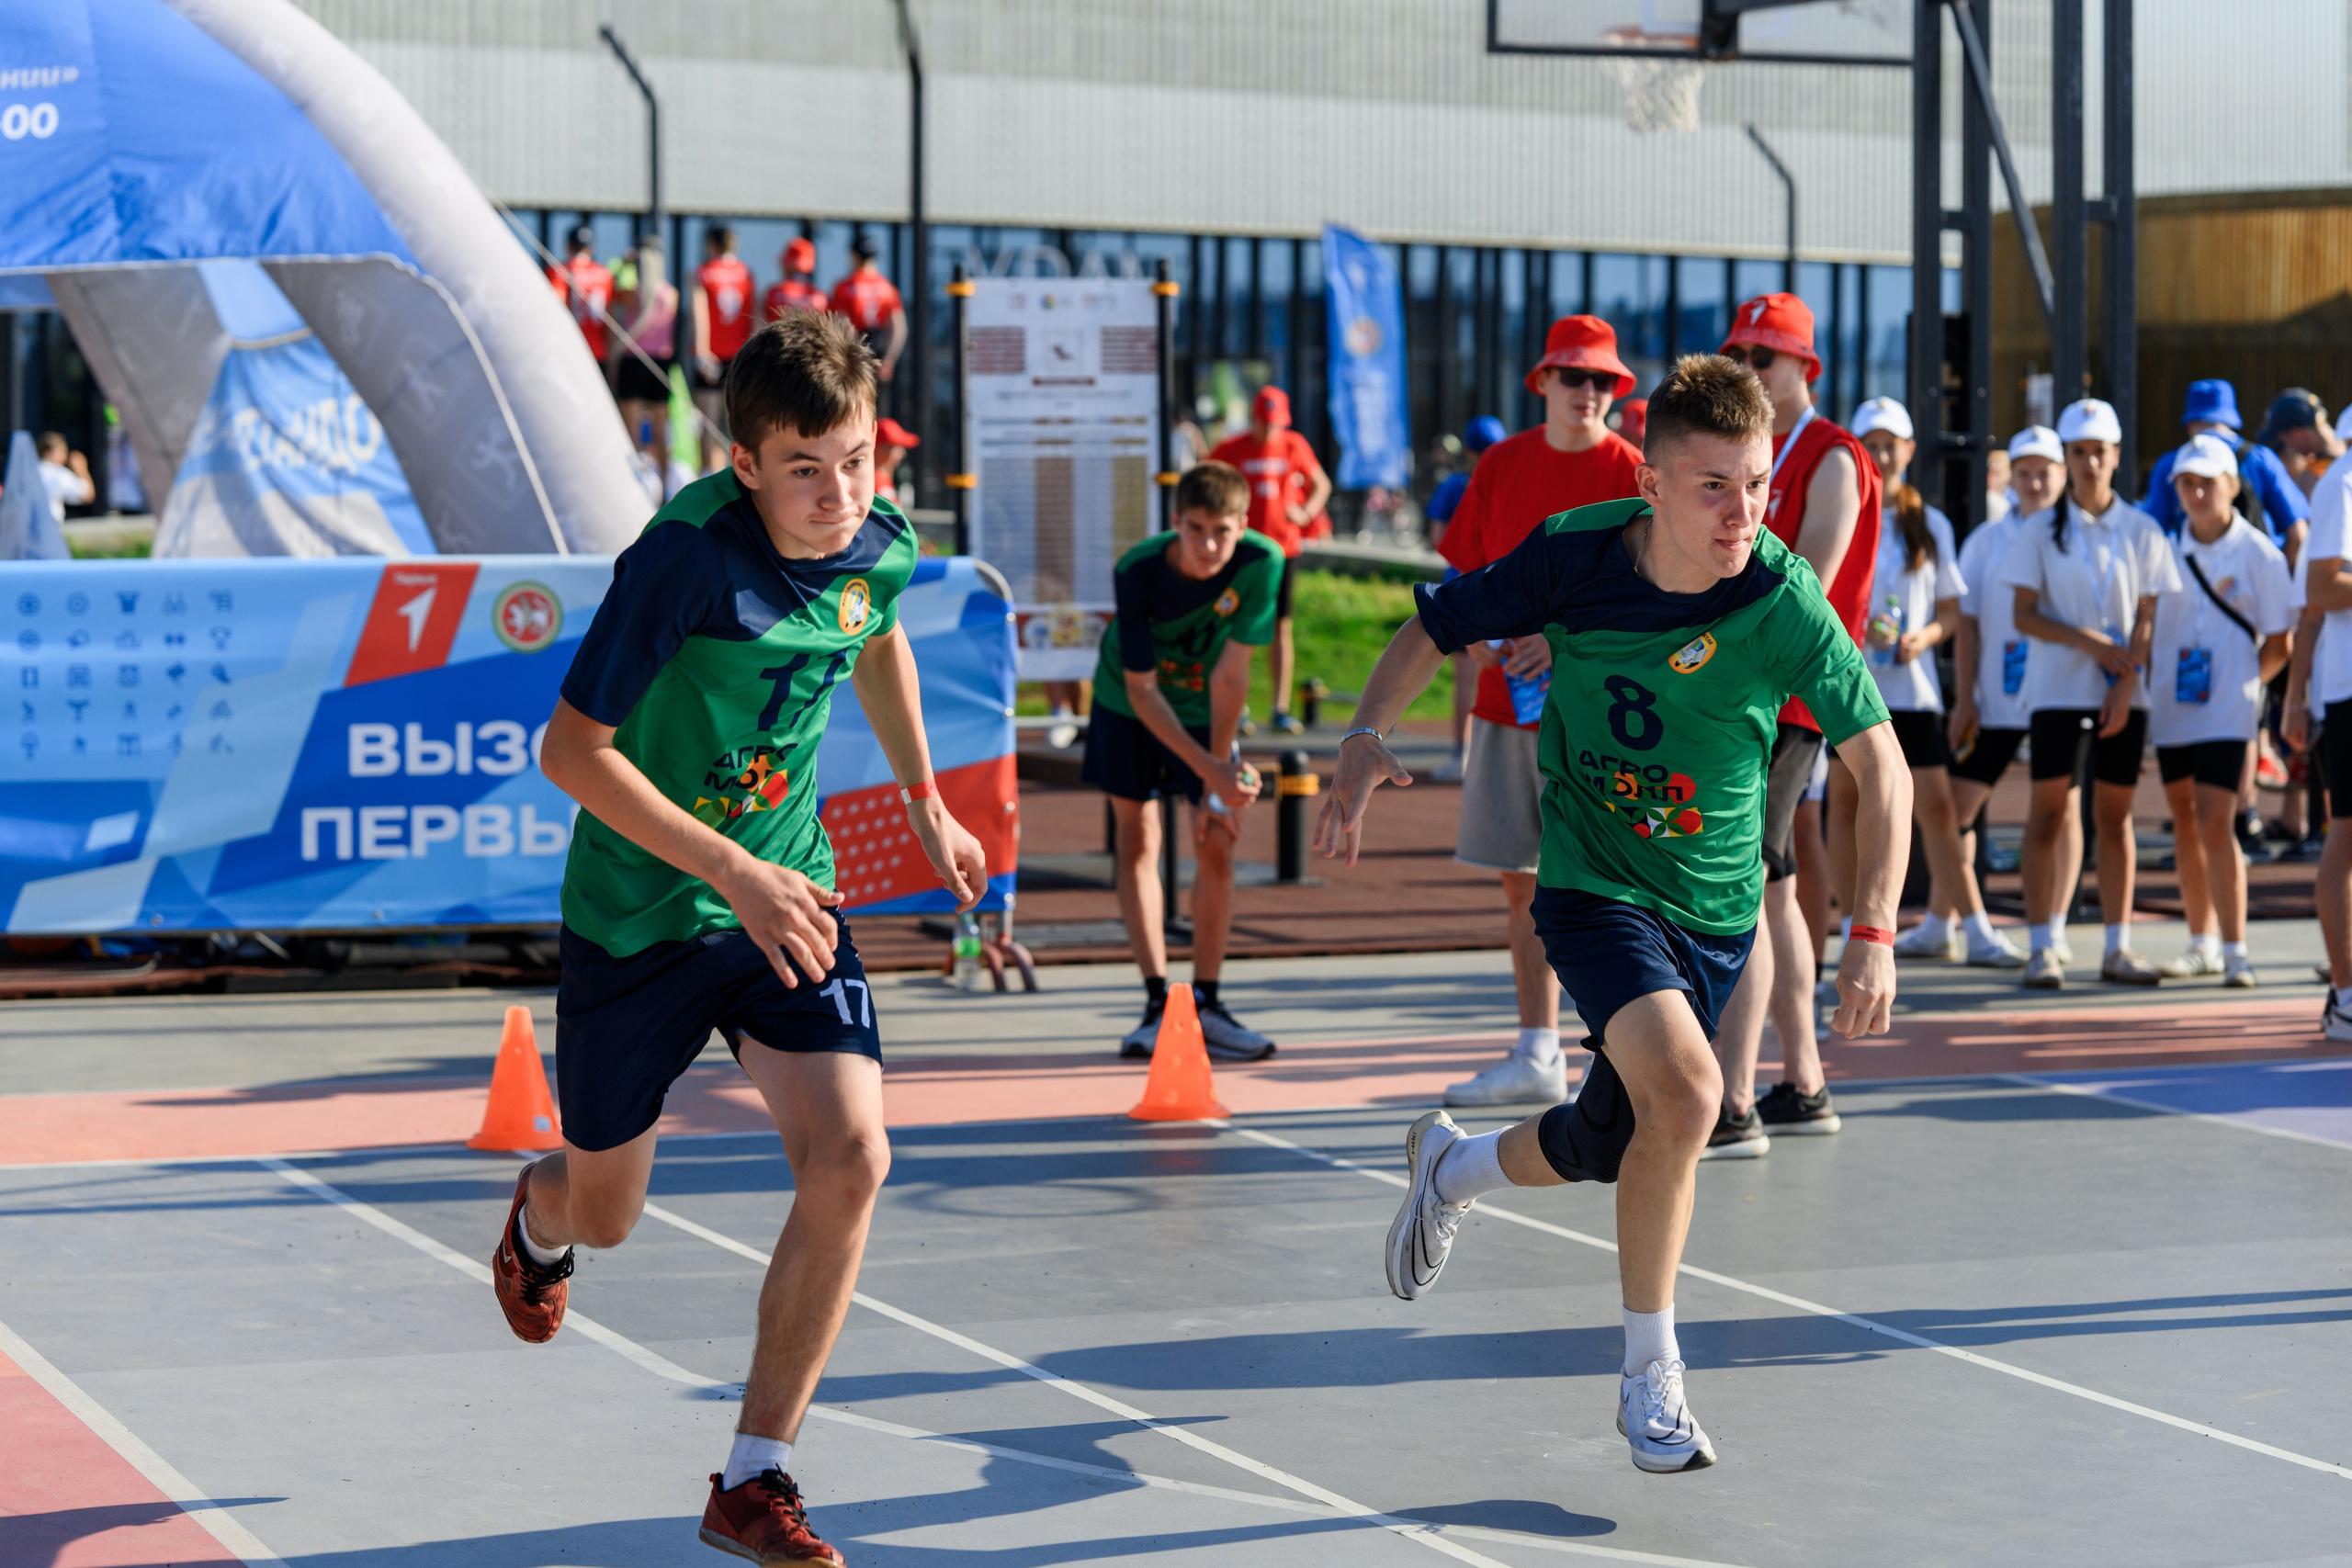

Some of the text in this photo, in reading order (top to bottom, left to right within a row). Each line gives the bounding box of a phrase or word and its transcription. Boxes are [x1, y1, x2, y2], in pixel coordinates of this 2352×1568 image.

[1603, 674, 1664, 751] 8
[347, 719, 555, 778] ВЫЗ
[1578, 750, 1669, 784] АГРО
[819, 977, 871, 1030] 17
